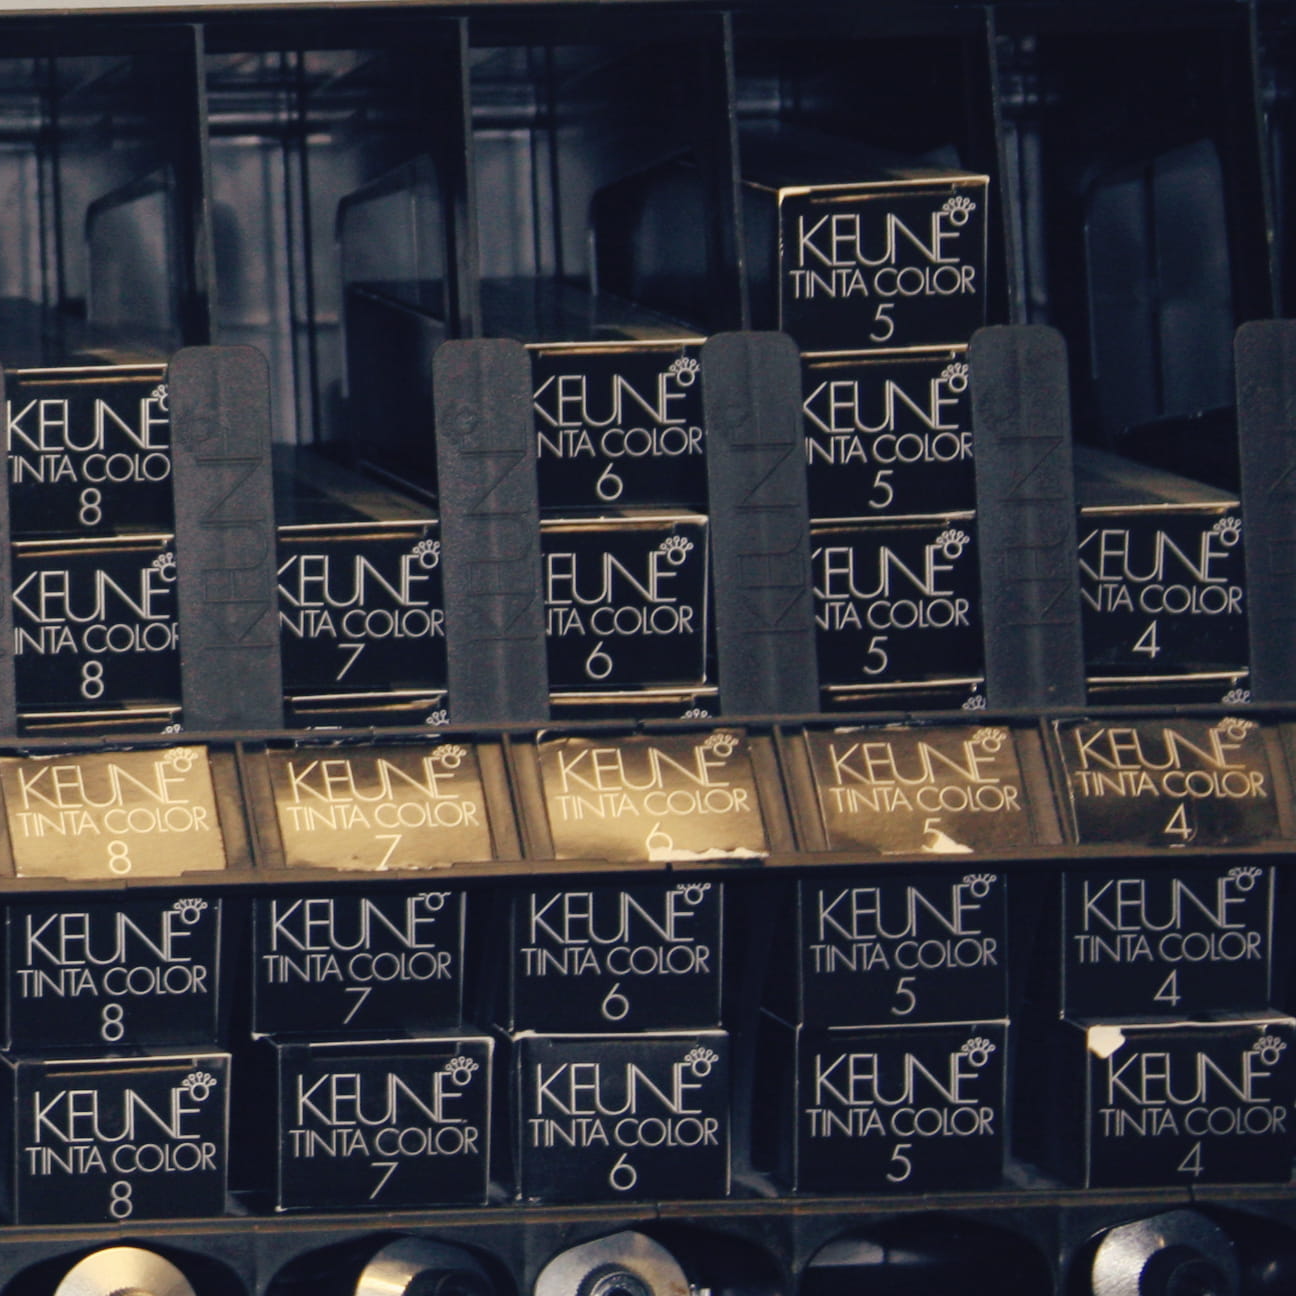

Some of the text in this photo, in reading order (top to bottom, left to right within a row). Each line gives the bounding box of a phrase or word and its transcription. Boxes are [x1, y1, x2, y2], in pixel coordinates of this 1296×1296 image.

[799, 213, 960, 265] KEUNE
[790, 266, 976, 297] TINTA COLOR
[869, 304, 895, 341] 5
[1076, 728, 1242, 770] KEUNE
[17, 764, 188, 808] KEUNE
[289, 758, 459, 802] KEUNE
[1076, 771, 1267, 798] TINTA COLOR
[16, 807, 208, 835] TINTA COLOR
[285, 802, 479, 828] TINTA COLOR
[1165, 804, 1192, 839] 4
[107, 841, 132, 875] 8
[374, 835, 401, 870] 7
[1084, 879, 1245, 931] KEUNE
[1074, 932, 1261, 963] TINTA COLOR
[1154, 970, 1180, 1006] 4
[537, 1064, 702, 1115] KEUNE
[529, 1119, 718, 1147] TINTA COLOR
[610, 1154, 637, 1191] 6
